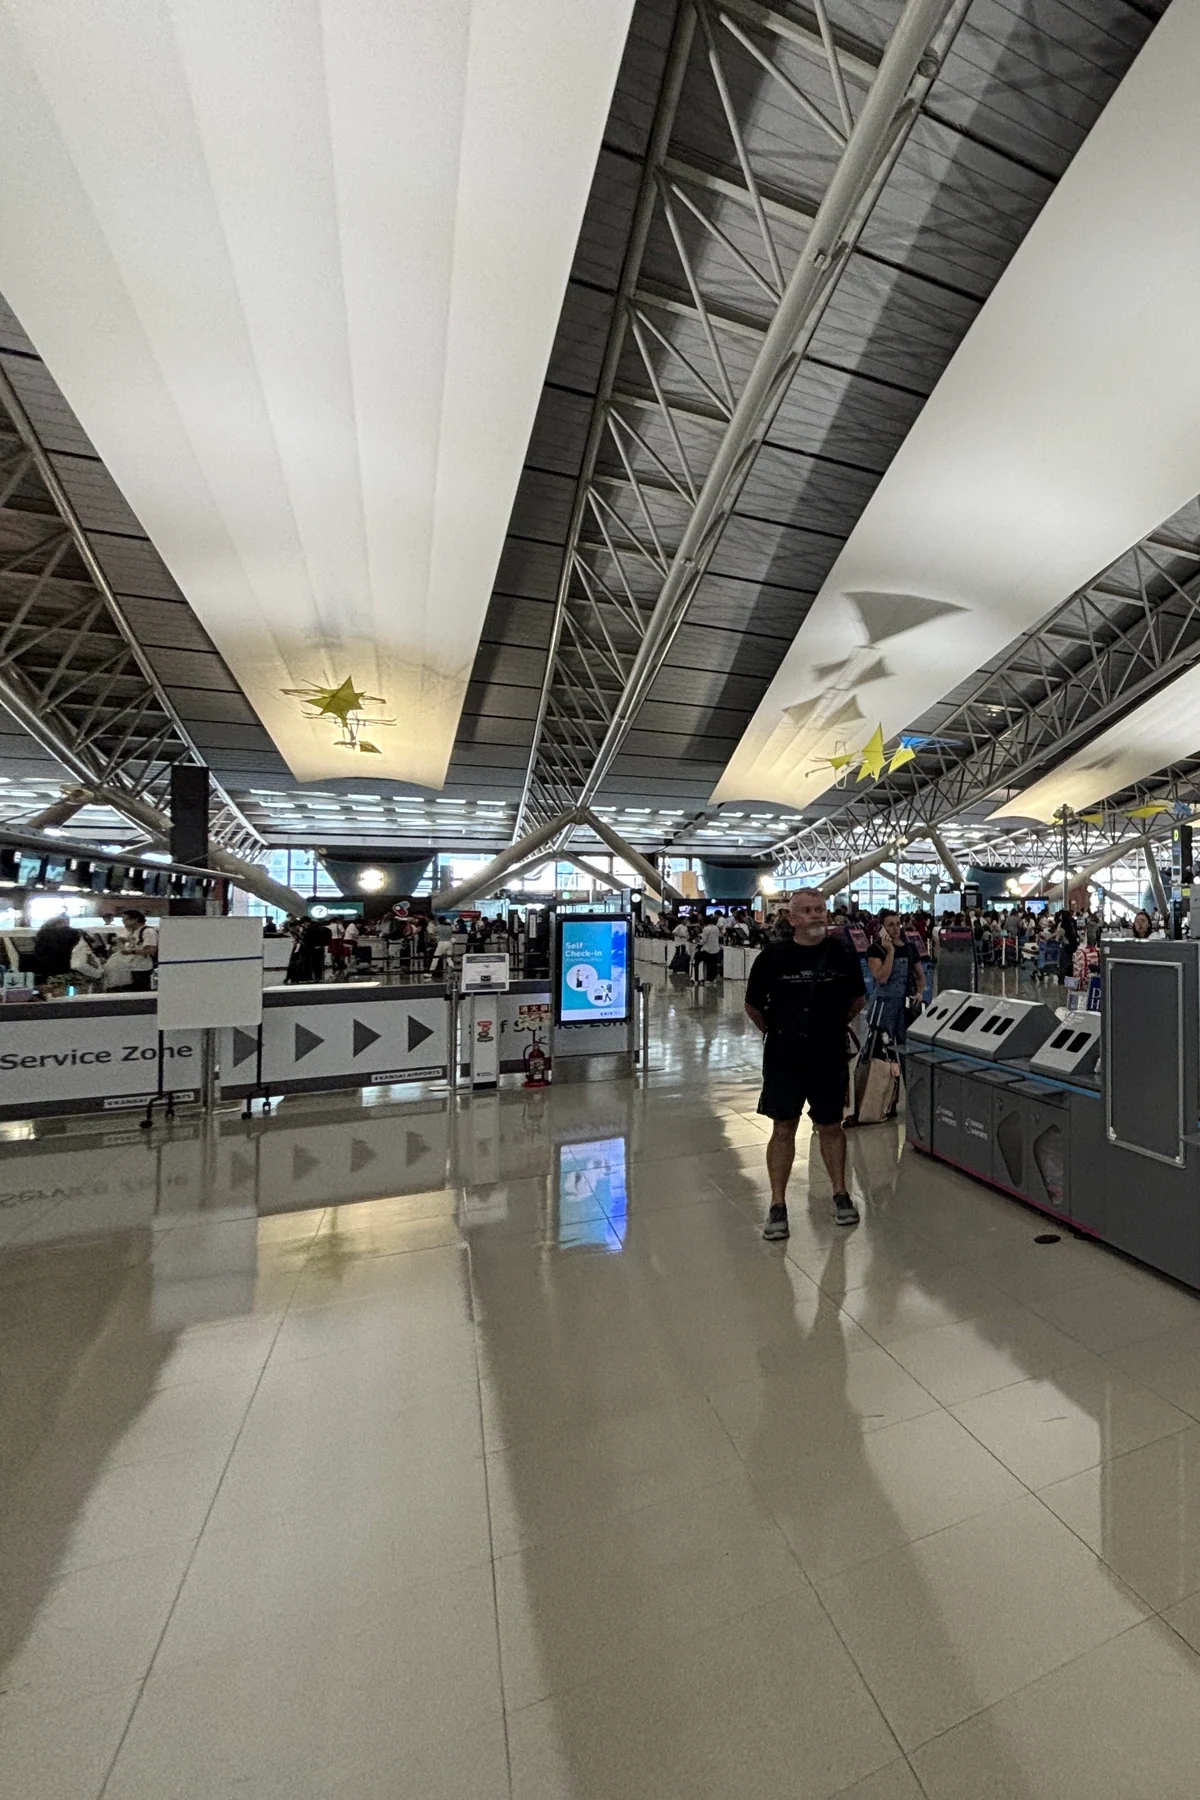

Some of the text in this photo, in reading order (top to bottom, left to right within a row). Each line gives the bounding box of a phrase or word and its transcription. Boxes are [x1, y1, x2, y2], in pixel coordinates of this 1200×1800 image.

[1173, 829, 1179, 841] D
[565, 941, 584, 950] Self
[0, 1044, 193, 1070] Service Zone
